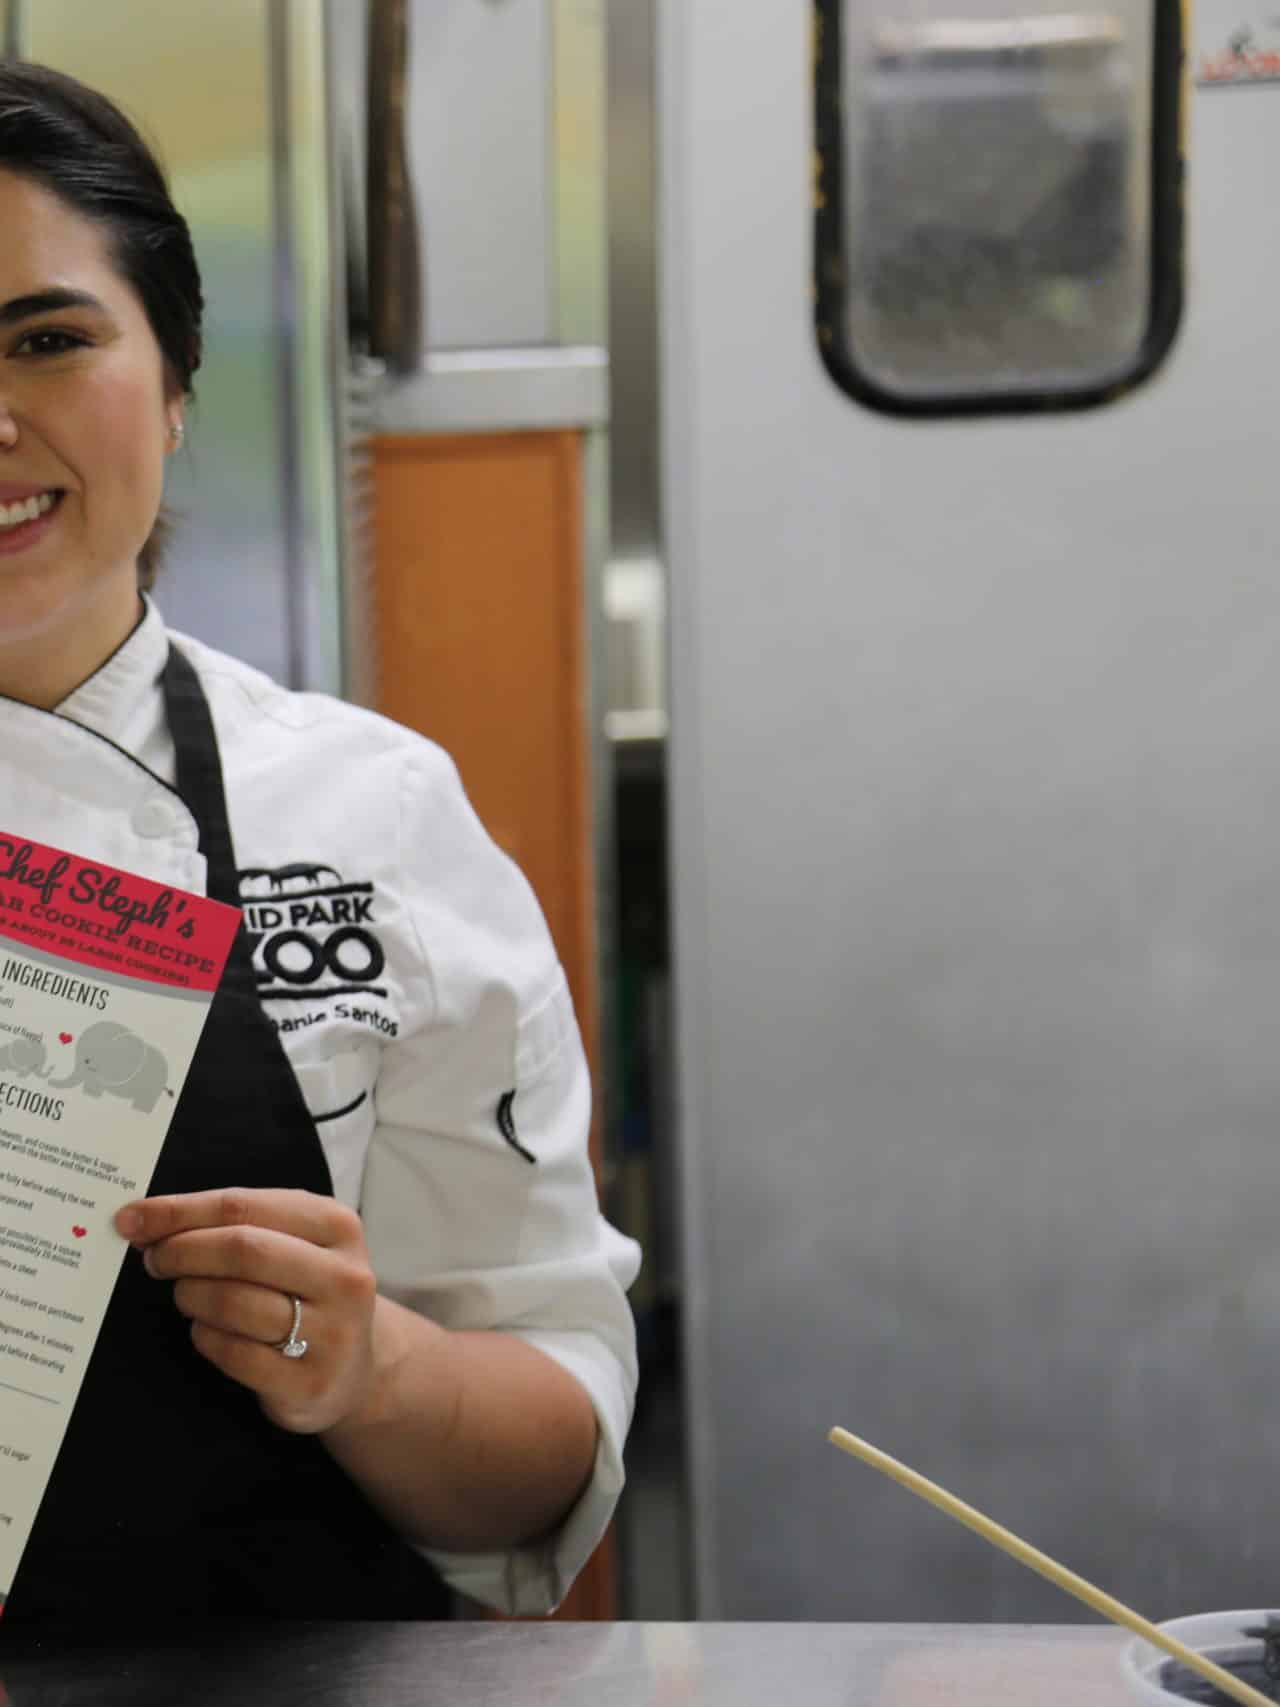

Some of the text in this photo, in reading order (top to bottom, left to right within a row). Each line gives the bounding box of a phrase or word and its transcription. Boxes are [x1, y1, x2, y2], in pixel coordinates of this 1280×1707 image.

[70, 868, 194, 939] Steph's
[248, 897, 374, 929] ID PARK
[29, 903, 119, 943] COOKIE
[125, 934, 216, 975] RECIPE
[0, 958, 111, 1011] INGREDIENTS
[334, 1004, 399, 1037] Santos
